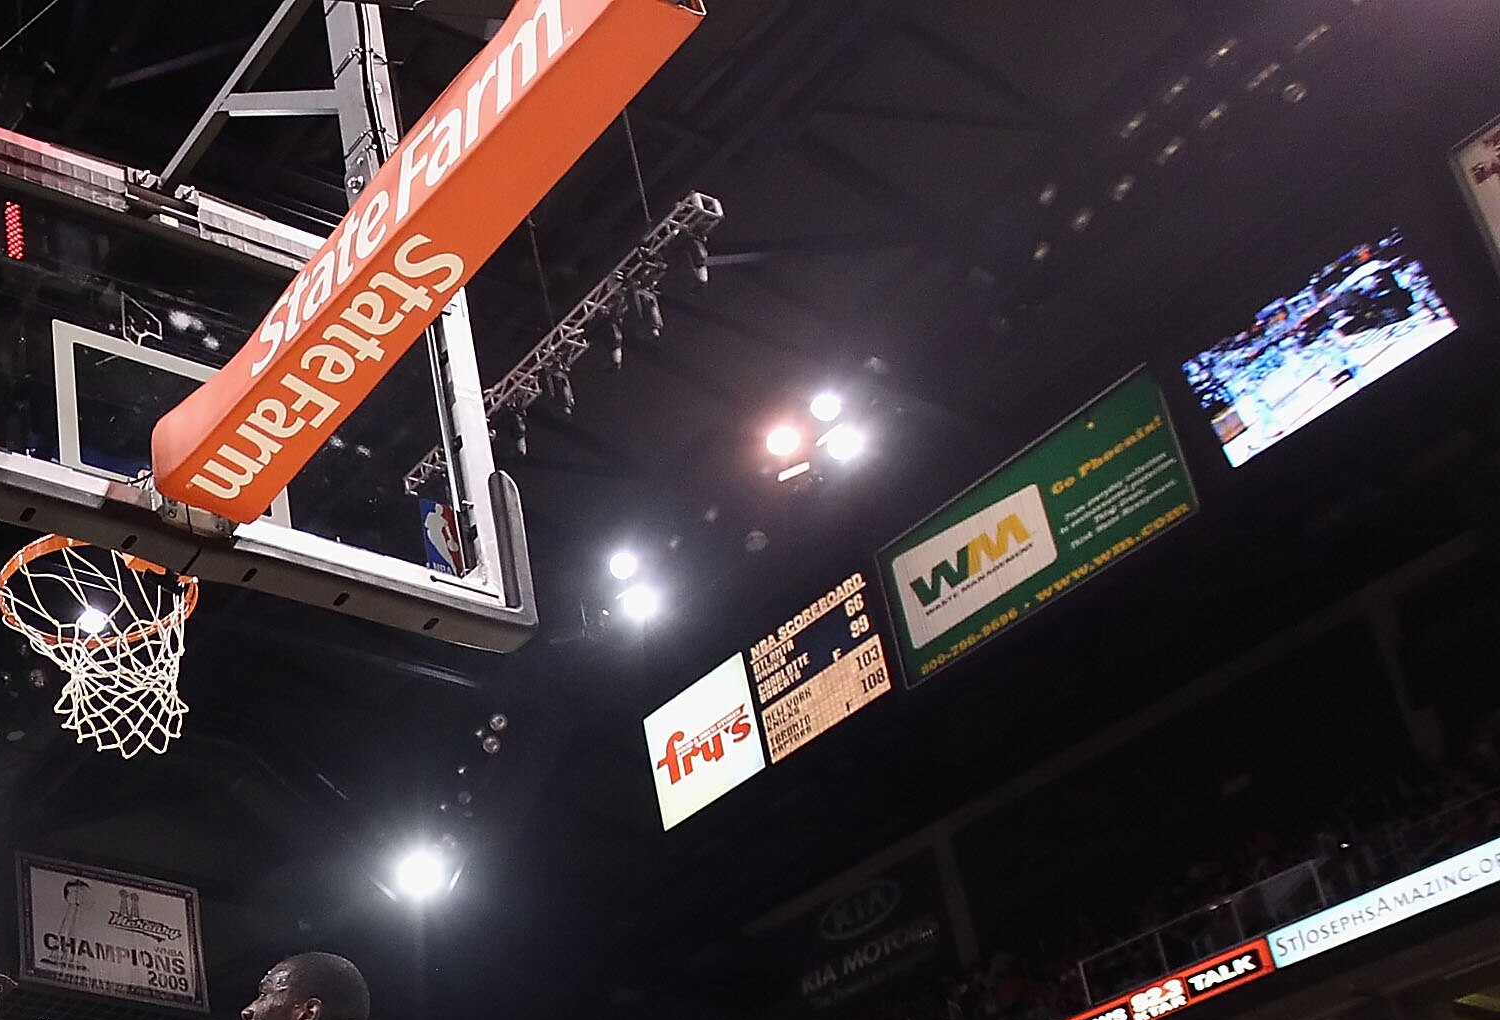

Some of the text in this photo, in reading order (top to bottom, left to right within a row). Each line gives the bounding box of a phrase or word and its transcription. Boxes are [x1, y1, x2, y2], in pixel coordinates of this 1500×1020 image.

[250, 188, 390, 378] State
[190, 233, 466, 500] State Farm
[910, 513, 1032, 607] WM
[43, 933, 186, 976] CHAMPIONS
[147, 970, 190, 992] 2009
[1187, 953, 1257, 992] TALK
